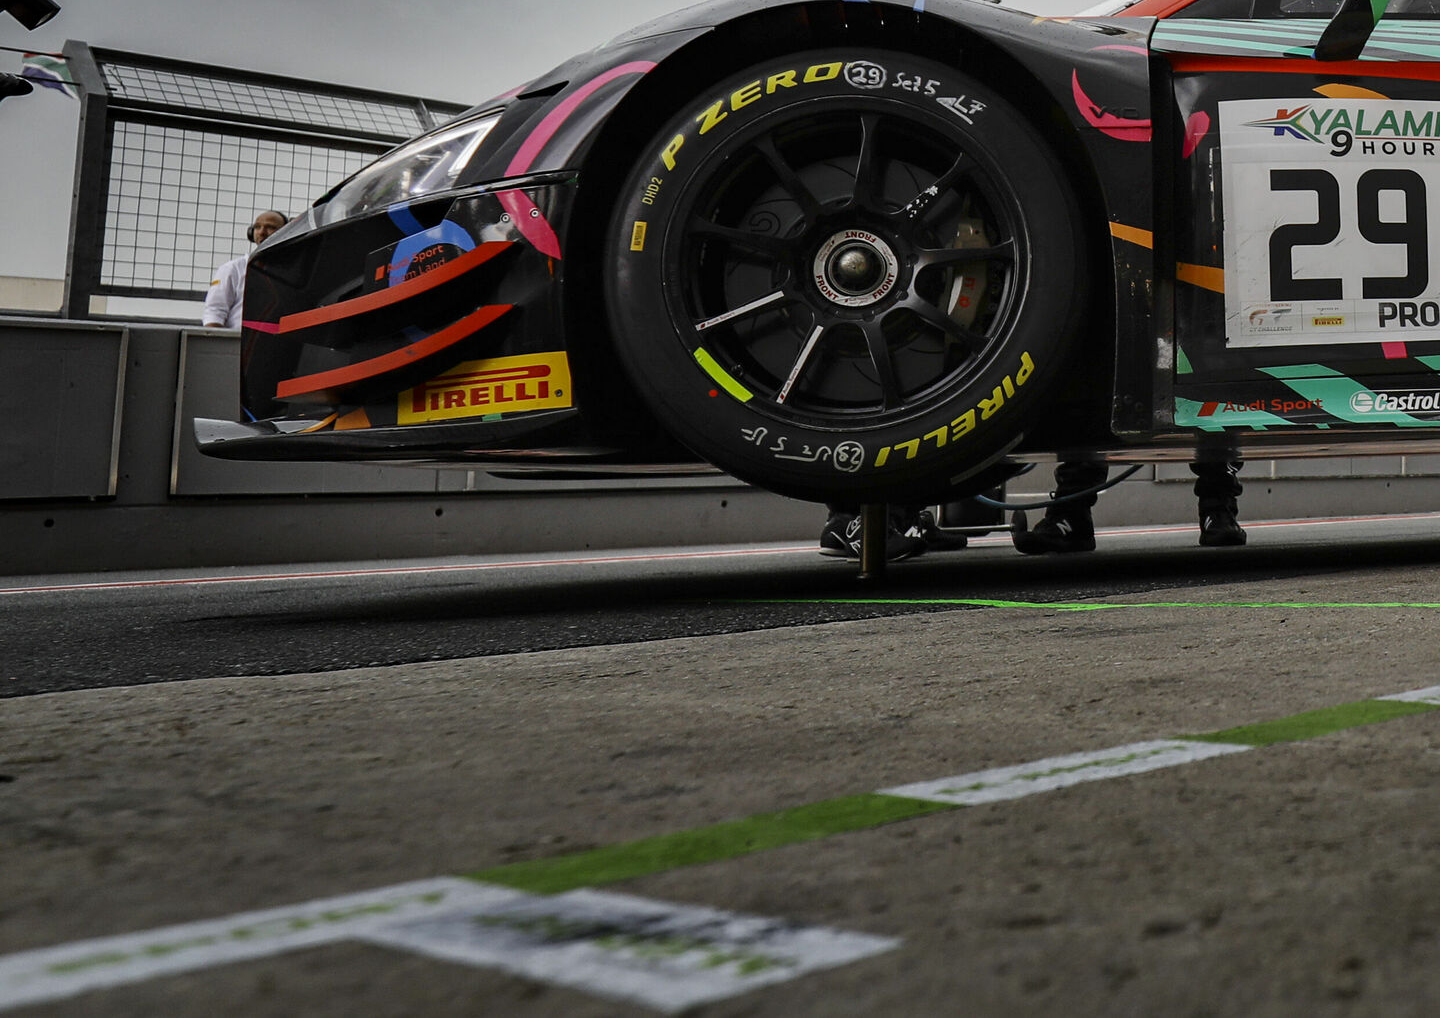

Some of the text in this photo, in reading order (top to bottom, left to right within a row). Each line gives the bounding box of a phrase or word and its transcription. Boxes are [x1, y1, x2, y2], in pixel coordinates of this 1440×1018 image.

[660, 61, 844, 171] P ZERO
[1330, 130, 1436, 157] 9 HOUR
[642, 176, 663, 205] DHD2
[845, 231, 876, 243] FRONT
[1269, 169, 1430, 301] 29
[412, 245, 444, 263] Sport
[816, 275, 838, 300] FRONT
[872, 273, 894, 299] FRONT
[1378, 301, 1440, 328] PRO
[413, 364, 551, 413] PIRELLI
[1374, 392, 1440, 412] Castrol
[874, 351, 1036, 467] PIRELLI
[1222, 397, 1323, 413] Audi Sport
